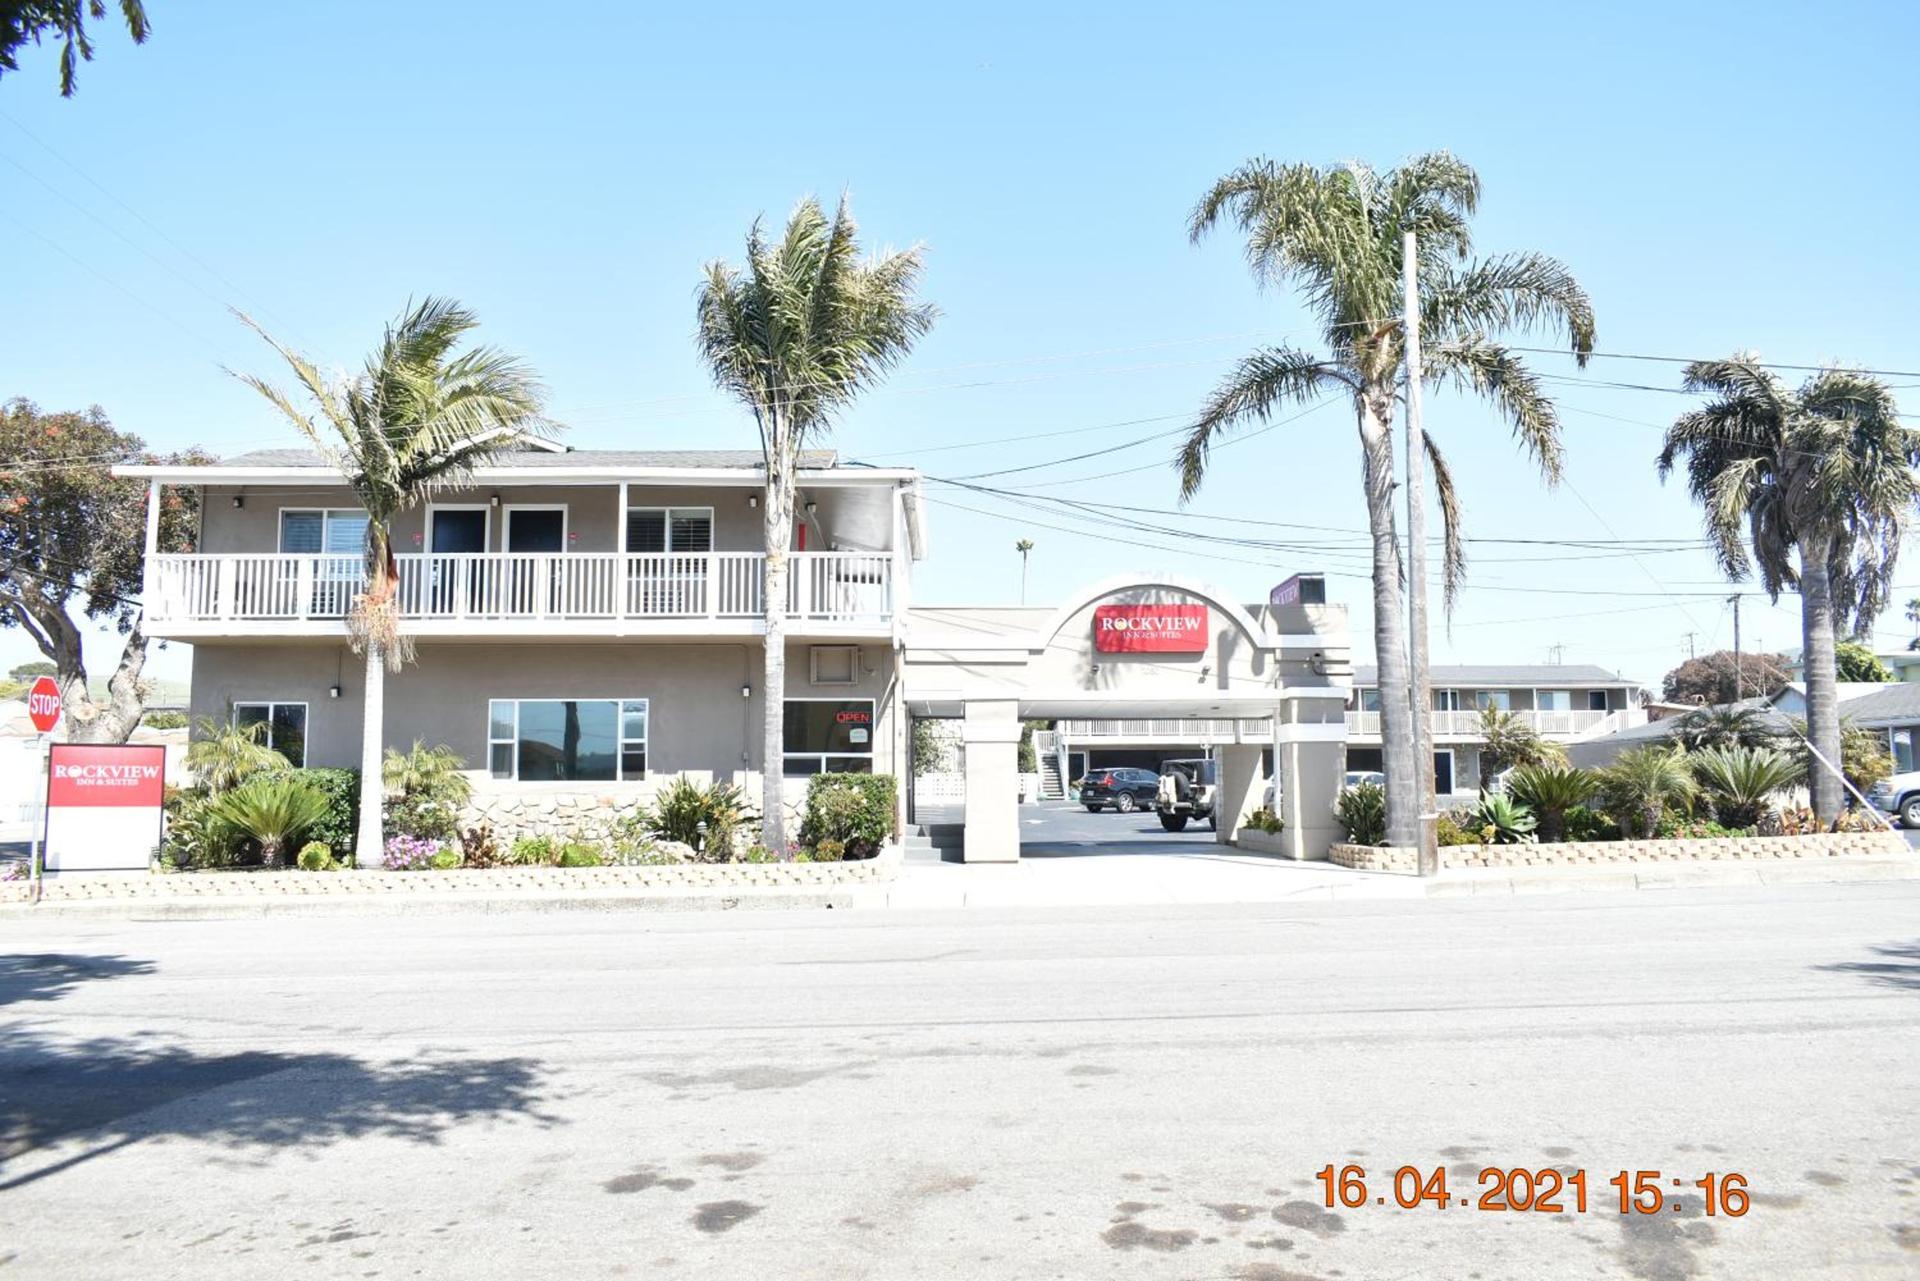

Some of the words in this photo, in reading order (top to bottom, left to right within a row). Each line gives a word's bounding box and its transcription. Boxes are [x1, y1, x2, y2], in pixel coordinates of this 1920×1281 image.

[1102, 617, 1201, 631] ROCKVIEW
[32, 693, 60, 715] STOP
[836, 712, 870, 723] OPEN
[55, 765, 160, 778] ROCKVIEW
